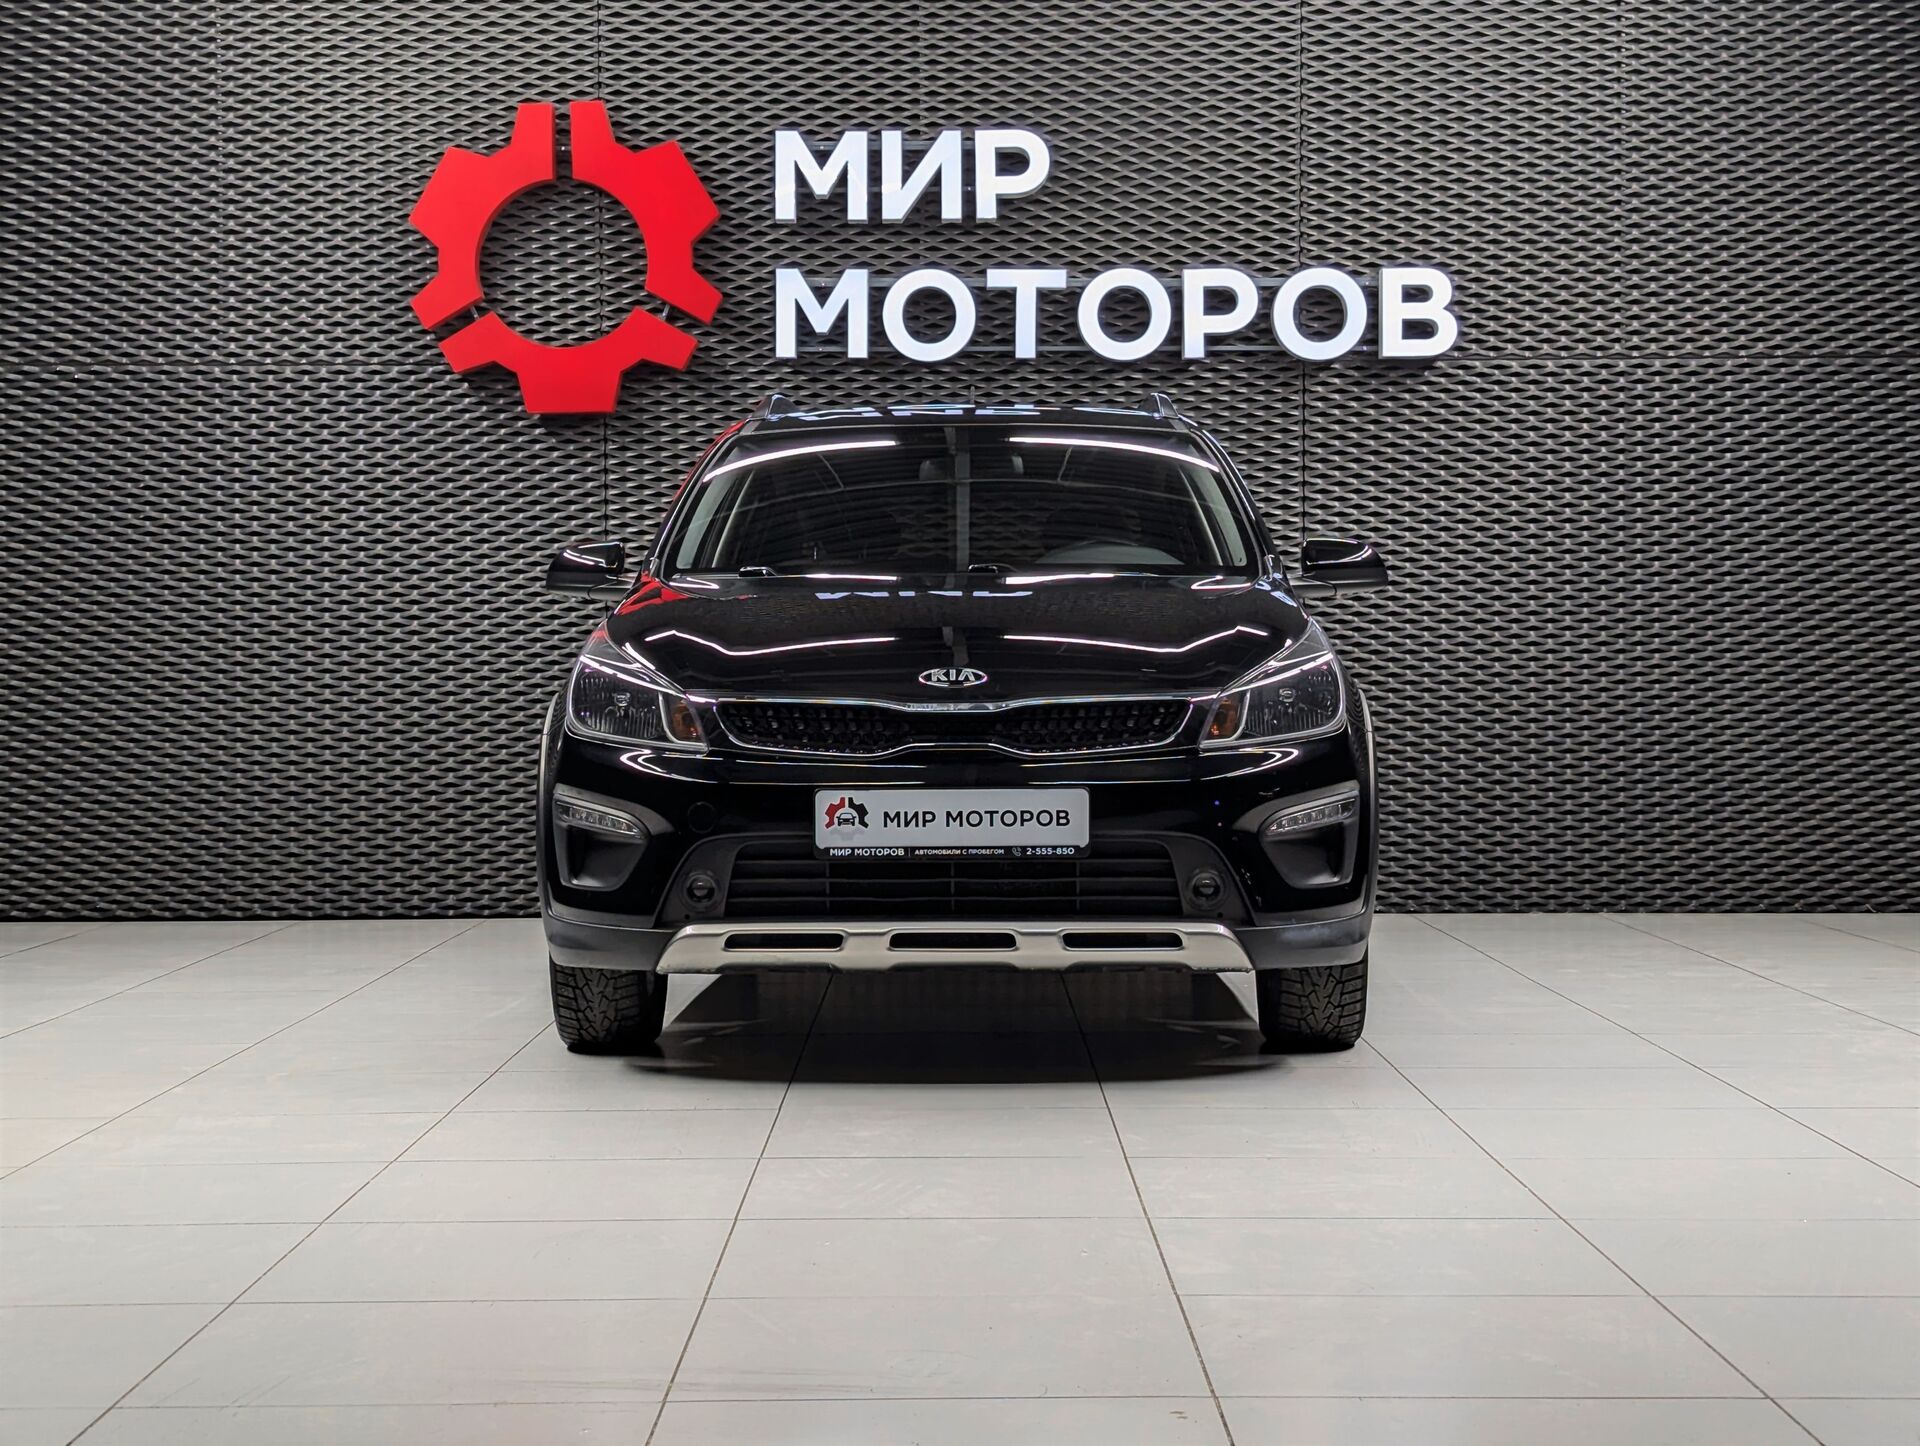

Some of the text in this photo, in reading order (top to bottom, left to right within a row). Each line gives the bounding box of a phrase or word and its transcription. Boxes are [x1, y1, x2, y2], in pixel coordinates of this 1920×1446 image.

[774, 129, 1051, 223] МИР
[774, 267, 1460, 363] МОТОРОВ
[930, 669, 976, 682] KIA
[883, 809, 1071, 828] МИР МОТОРОВ
[829, 848, 852, 856] МИР
[854, 848, 905, 856] МОТОРОВ
[1026, 847, 1075, 855] 2-555-850
